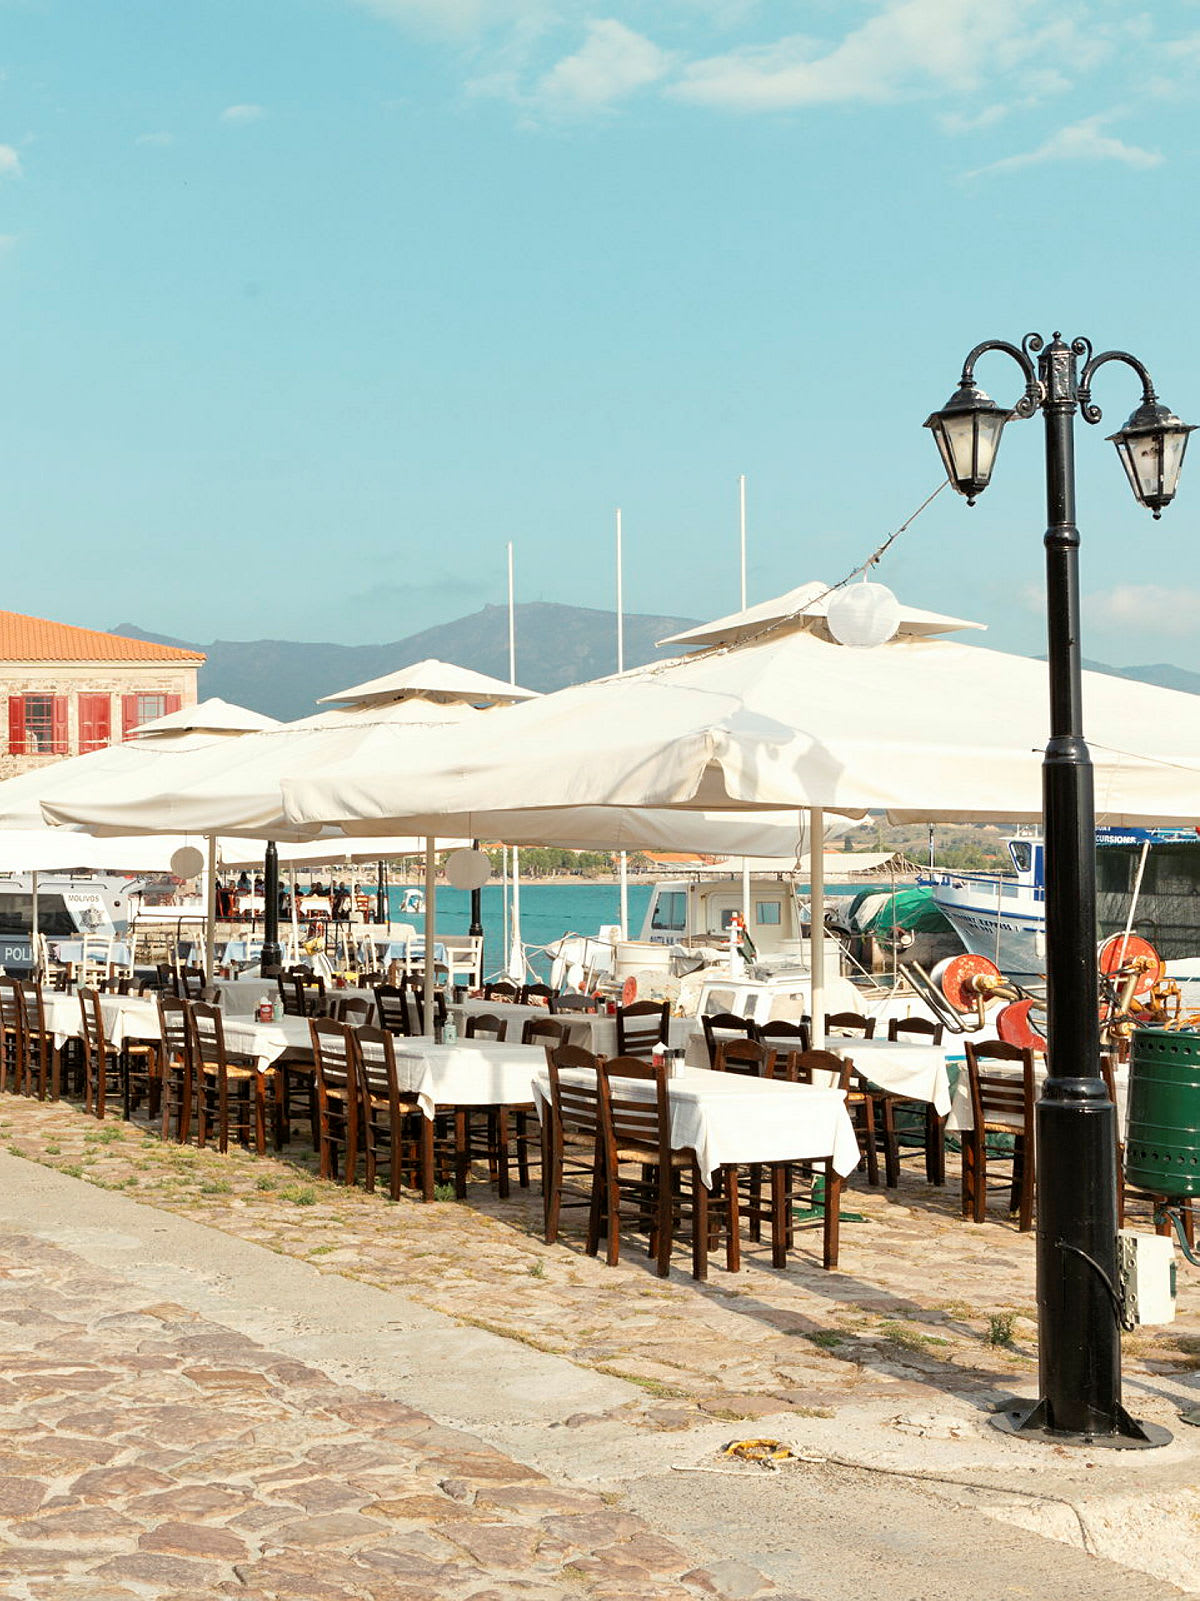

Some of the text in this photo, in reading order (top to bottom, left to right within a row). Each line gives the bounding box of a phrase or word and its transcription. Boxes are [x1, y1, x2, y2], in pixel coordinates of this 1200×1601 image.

[1095, 834, 1137, 844] CURSIONS
[68, 894, 100, 902] MOLIVOS
[4, 946, 33, 961] POLI
